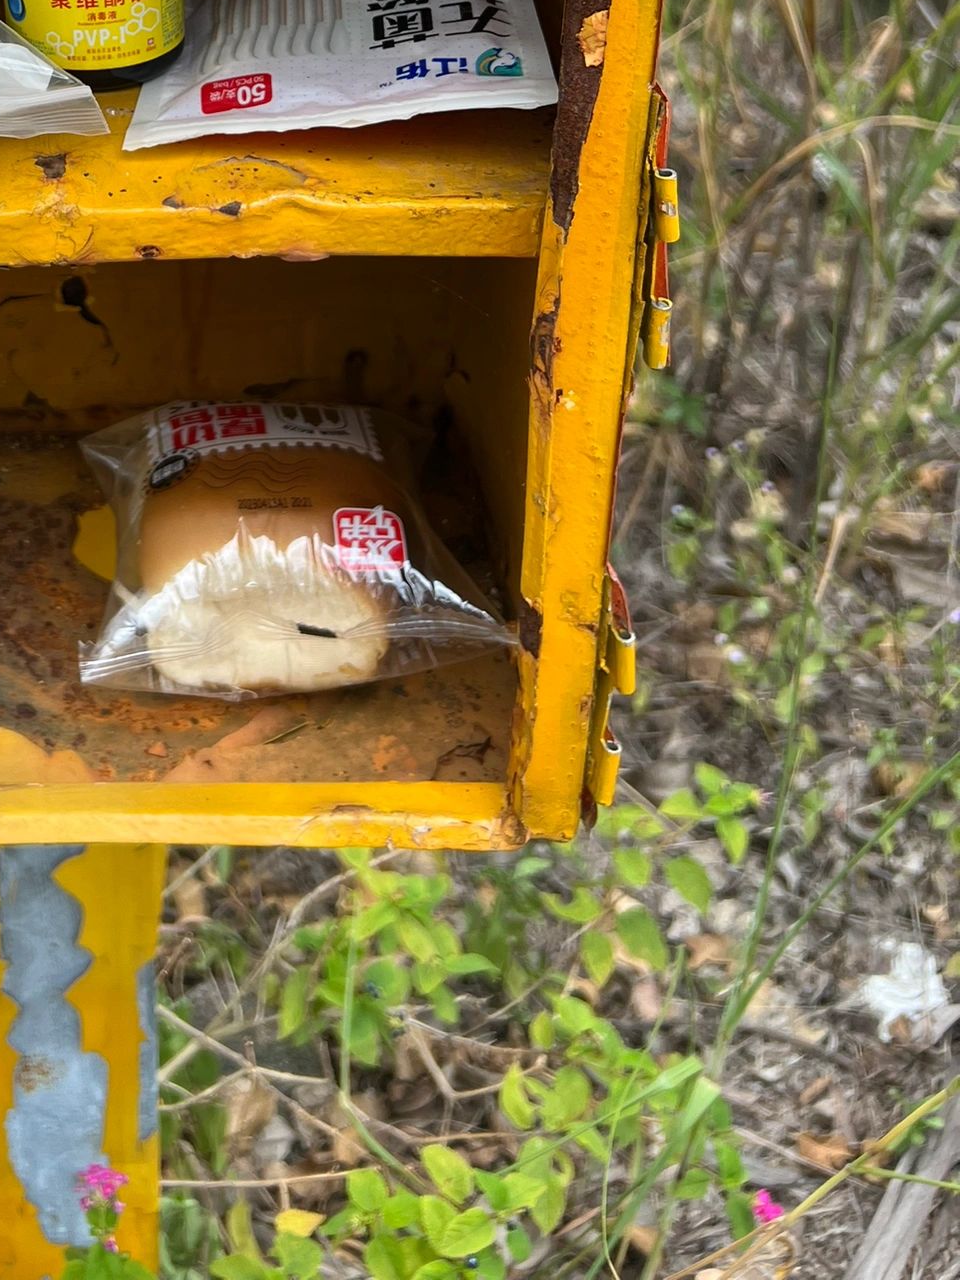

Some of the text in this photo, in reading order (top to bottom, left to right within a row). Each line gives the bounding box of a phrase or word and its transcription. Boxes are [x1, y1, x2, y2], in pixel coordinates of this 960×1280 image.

[87, 11, 117, 21] 消毒液
[369, 1, 510, 50] 无菌
[395, 57, 468, 81] 江佑
